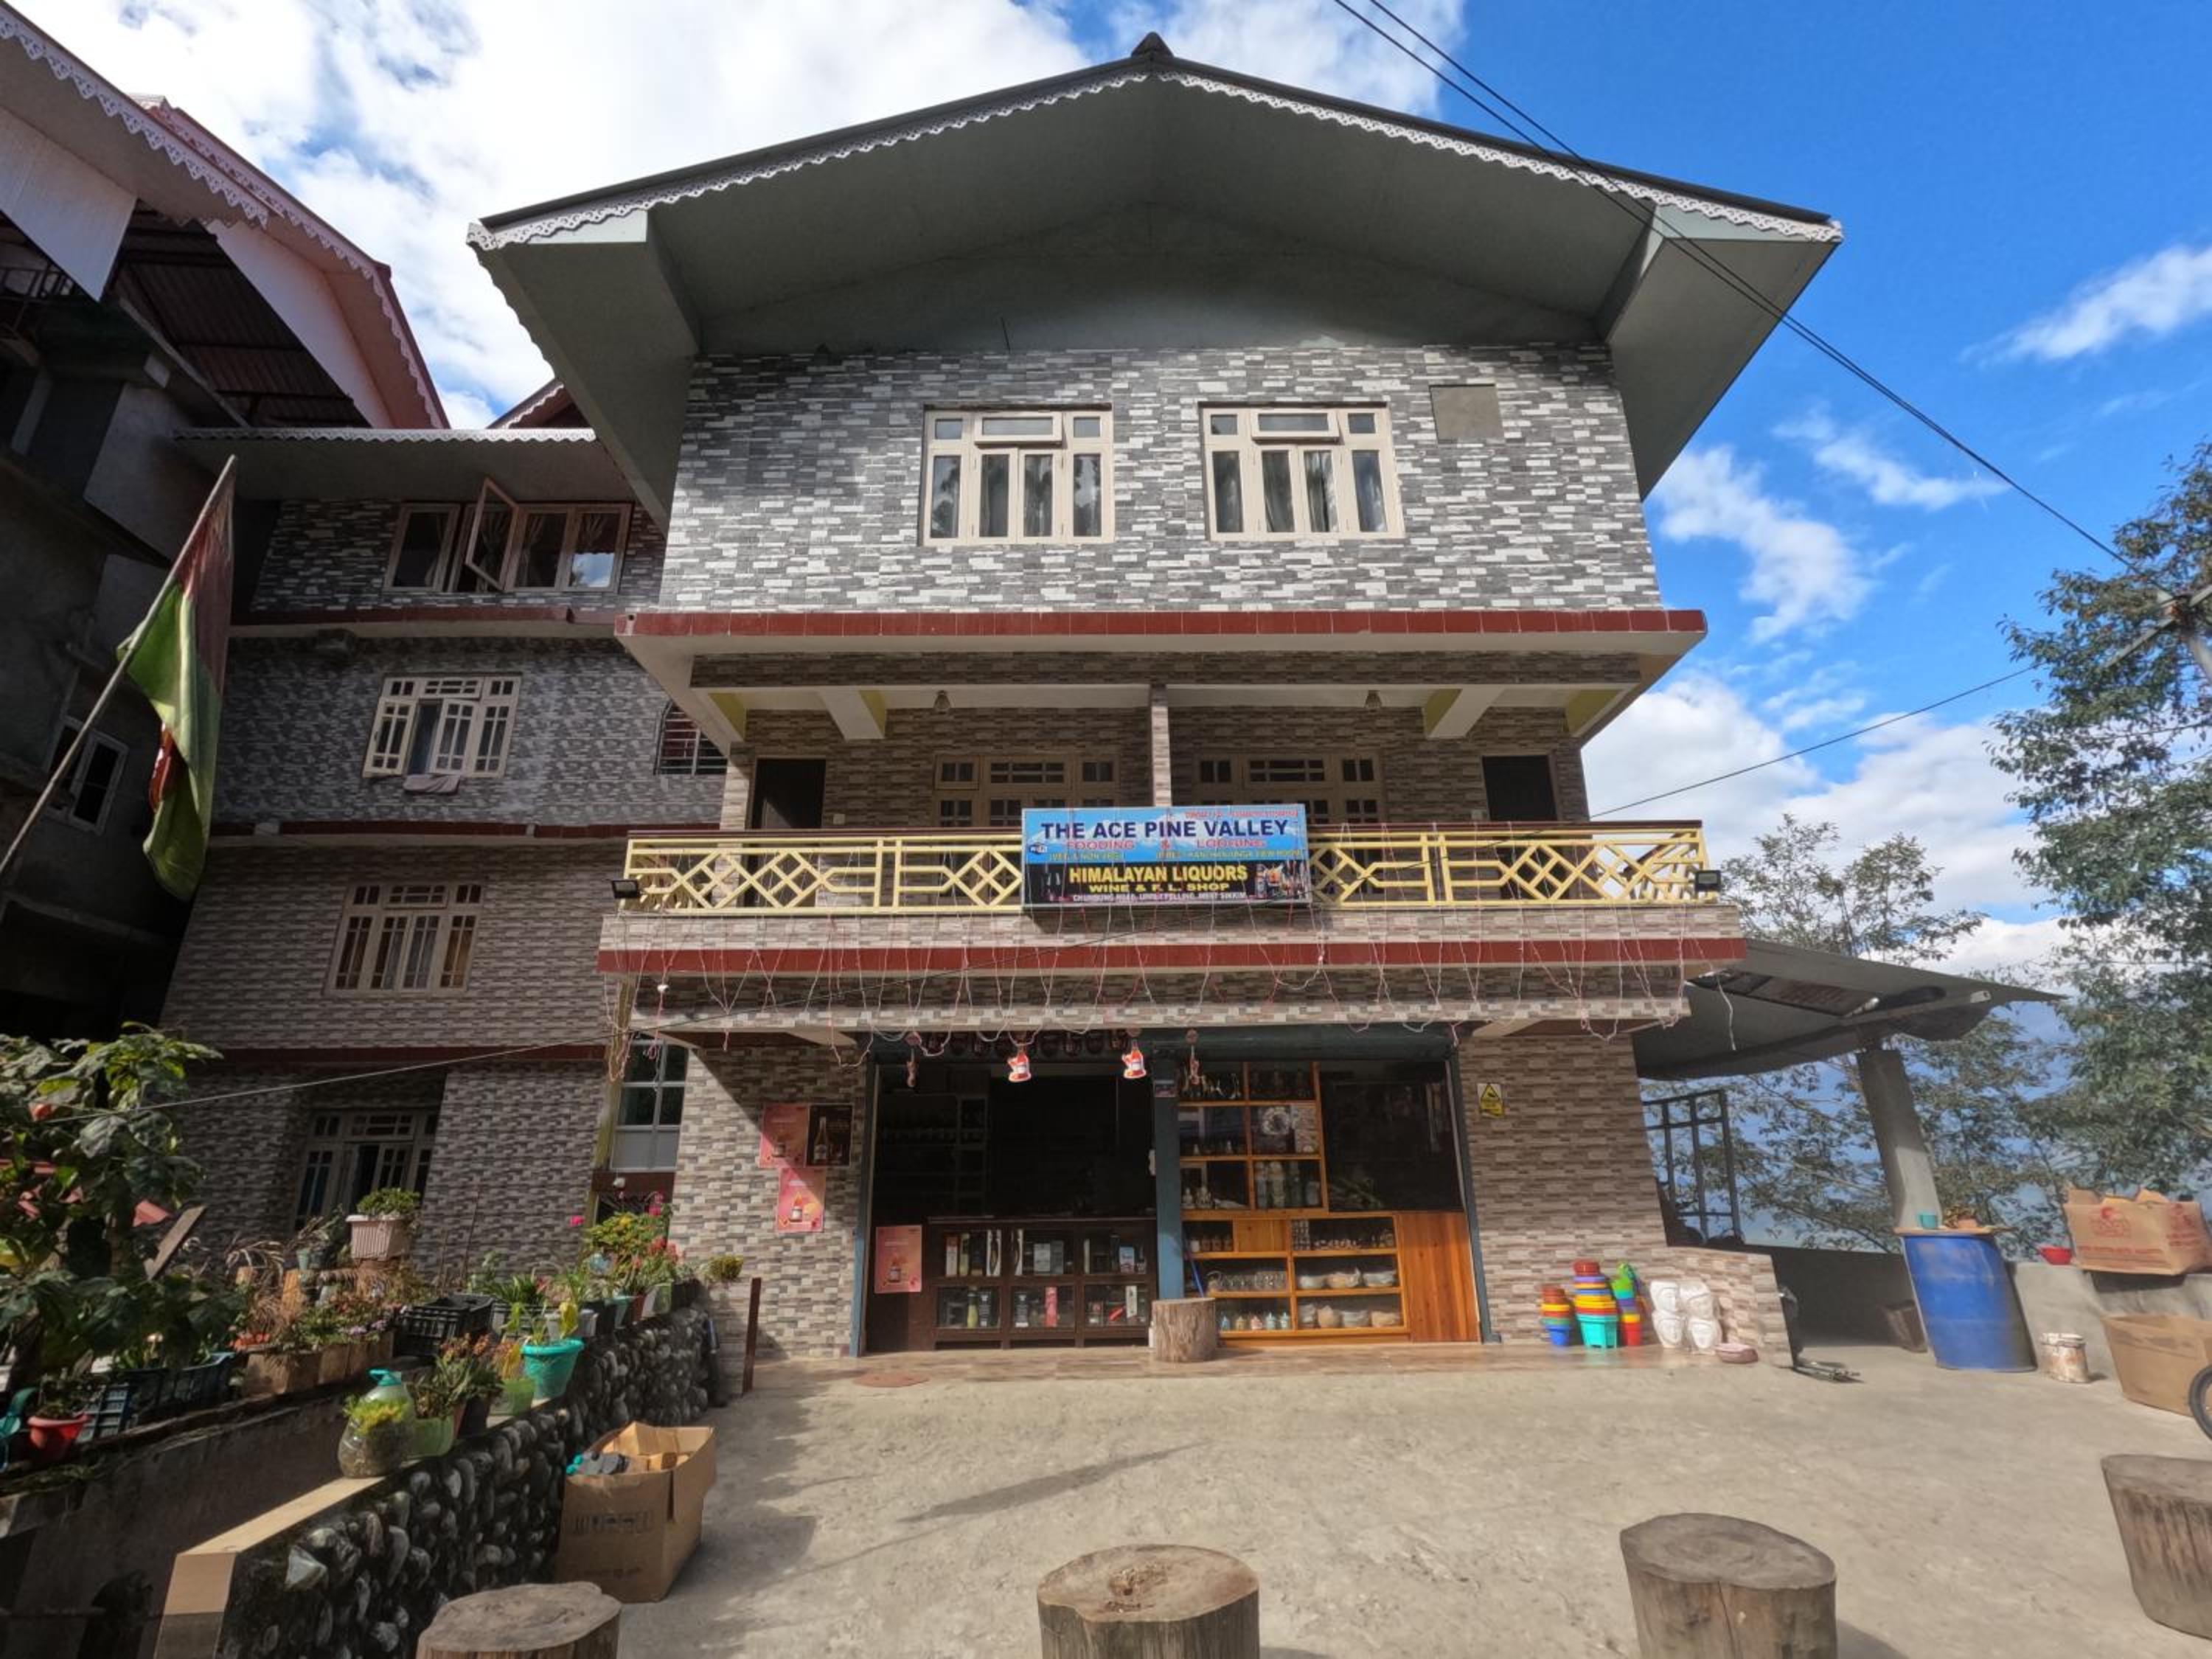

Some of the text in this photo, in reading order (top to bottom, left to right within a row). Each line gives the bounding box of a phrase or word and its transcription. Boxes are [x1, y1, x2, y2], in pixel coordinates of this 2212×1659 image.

[1041, 820, 1289, 838] THE ACE PINE VALLEY
[1067, 840, 1135, 850] FOODING
[1069, 865, 1248, 883] HIMALAYAN LIQUORS
[1089, 884, 1130, 893] WINE
[1135, 884, 1146, 892] &
[1186, 883, 1230, 891] SHOP
